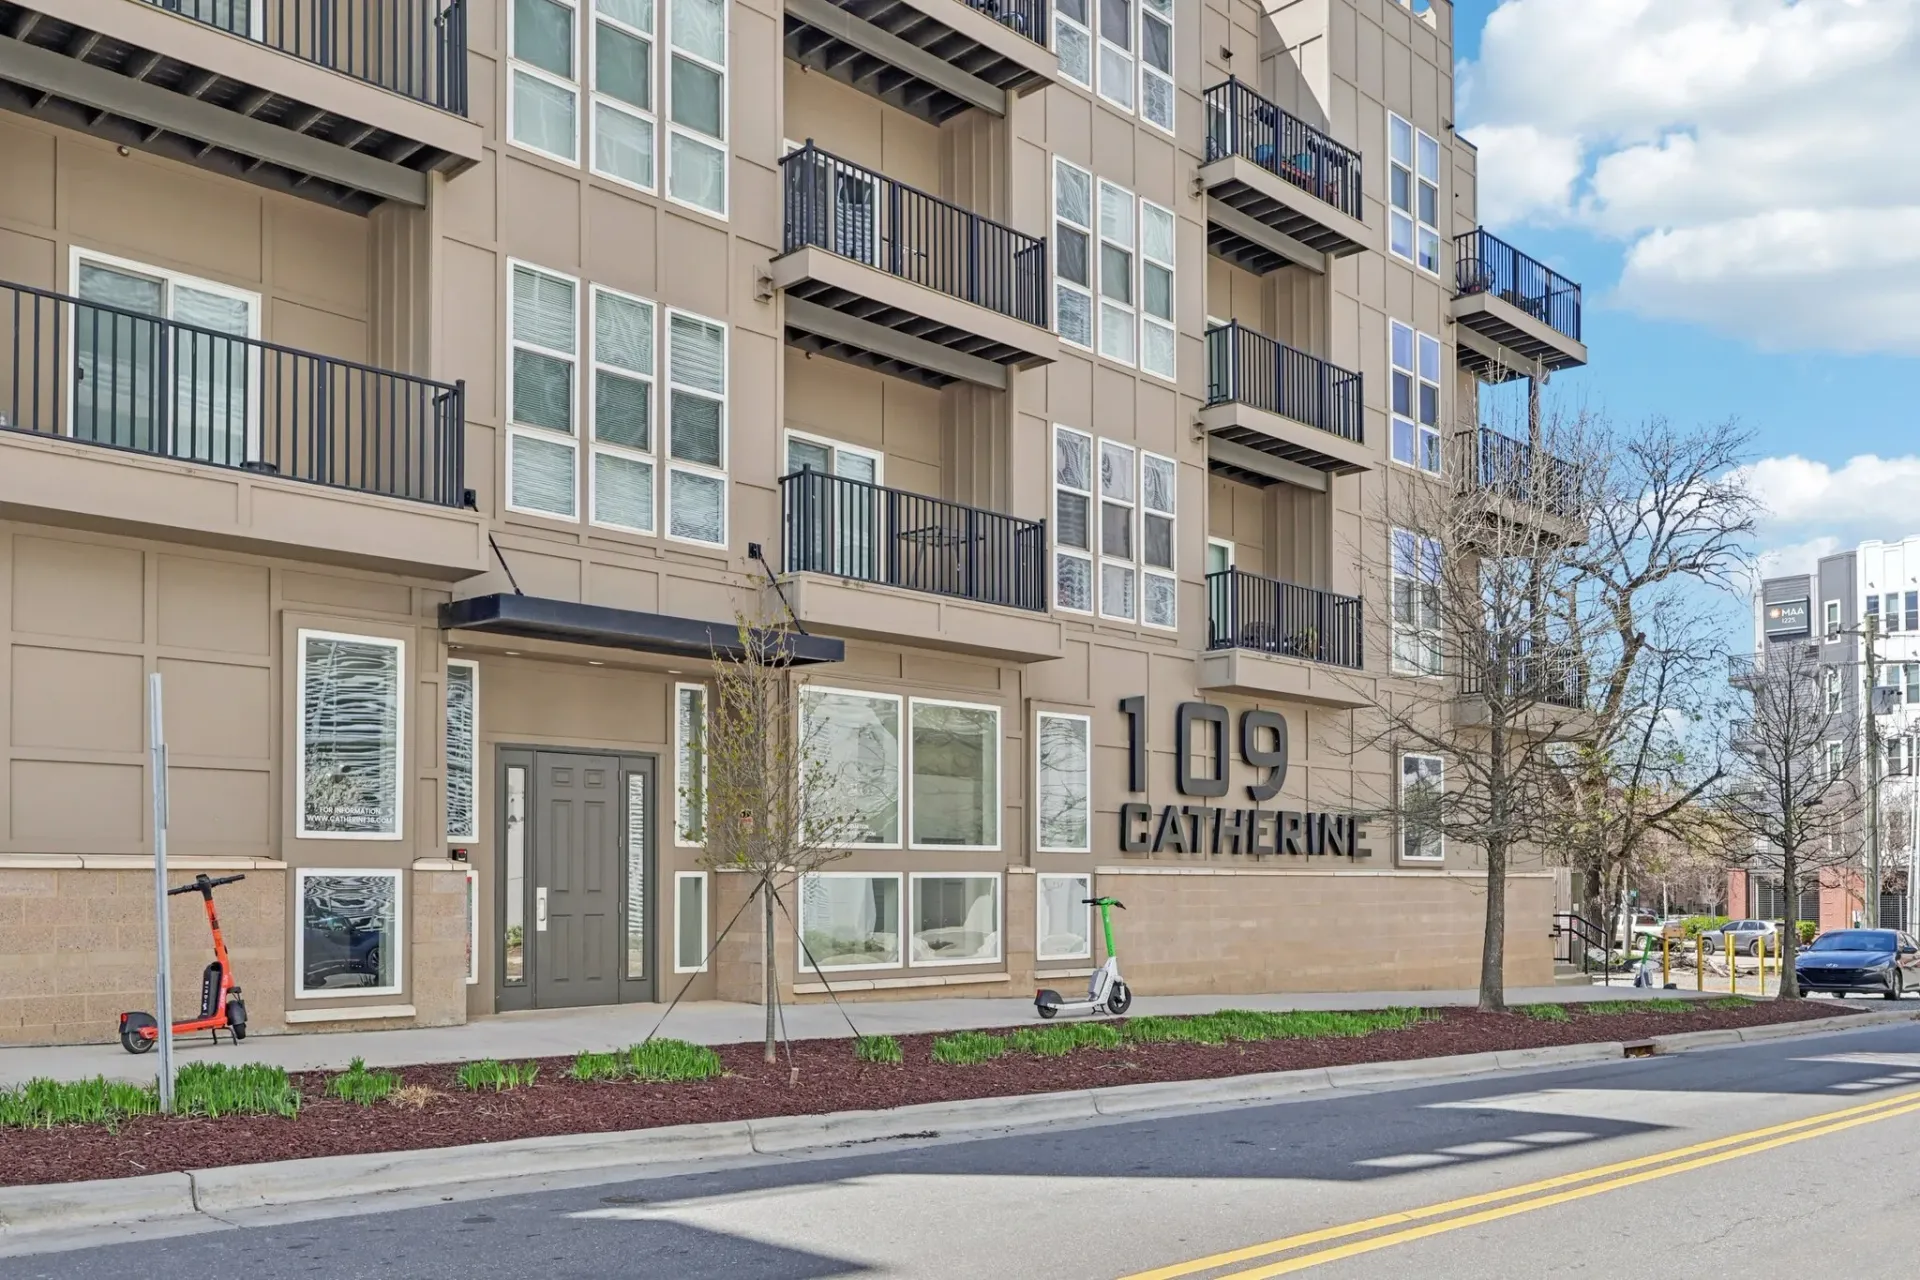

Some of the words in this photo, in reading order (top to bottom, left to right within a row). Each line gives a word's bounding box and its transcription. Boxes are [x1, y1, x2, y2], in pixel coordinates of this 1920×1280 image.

[1781, 606, 1804, 617] MAA
[1119, 695, 1289, 801] 109
[319, 806, 334, 814] FOR
[1120, 803, 1373, 858] CATHERINE
